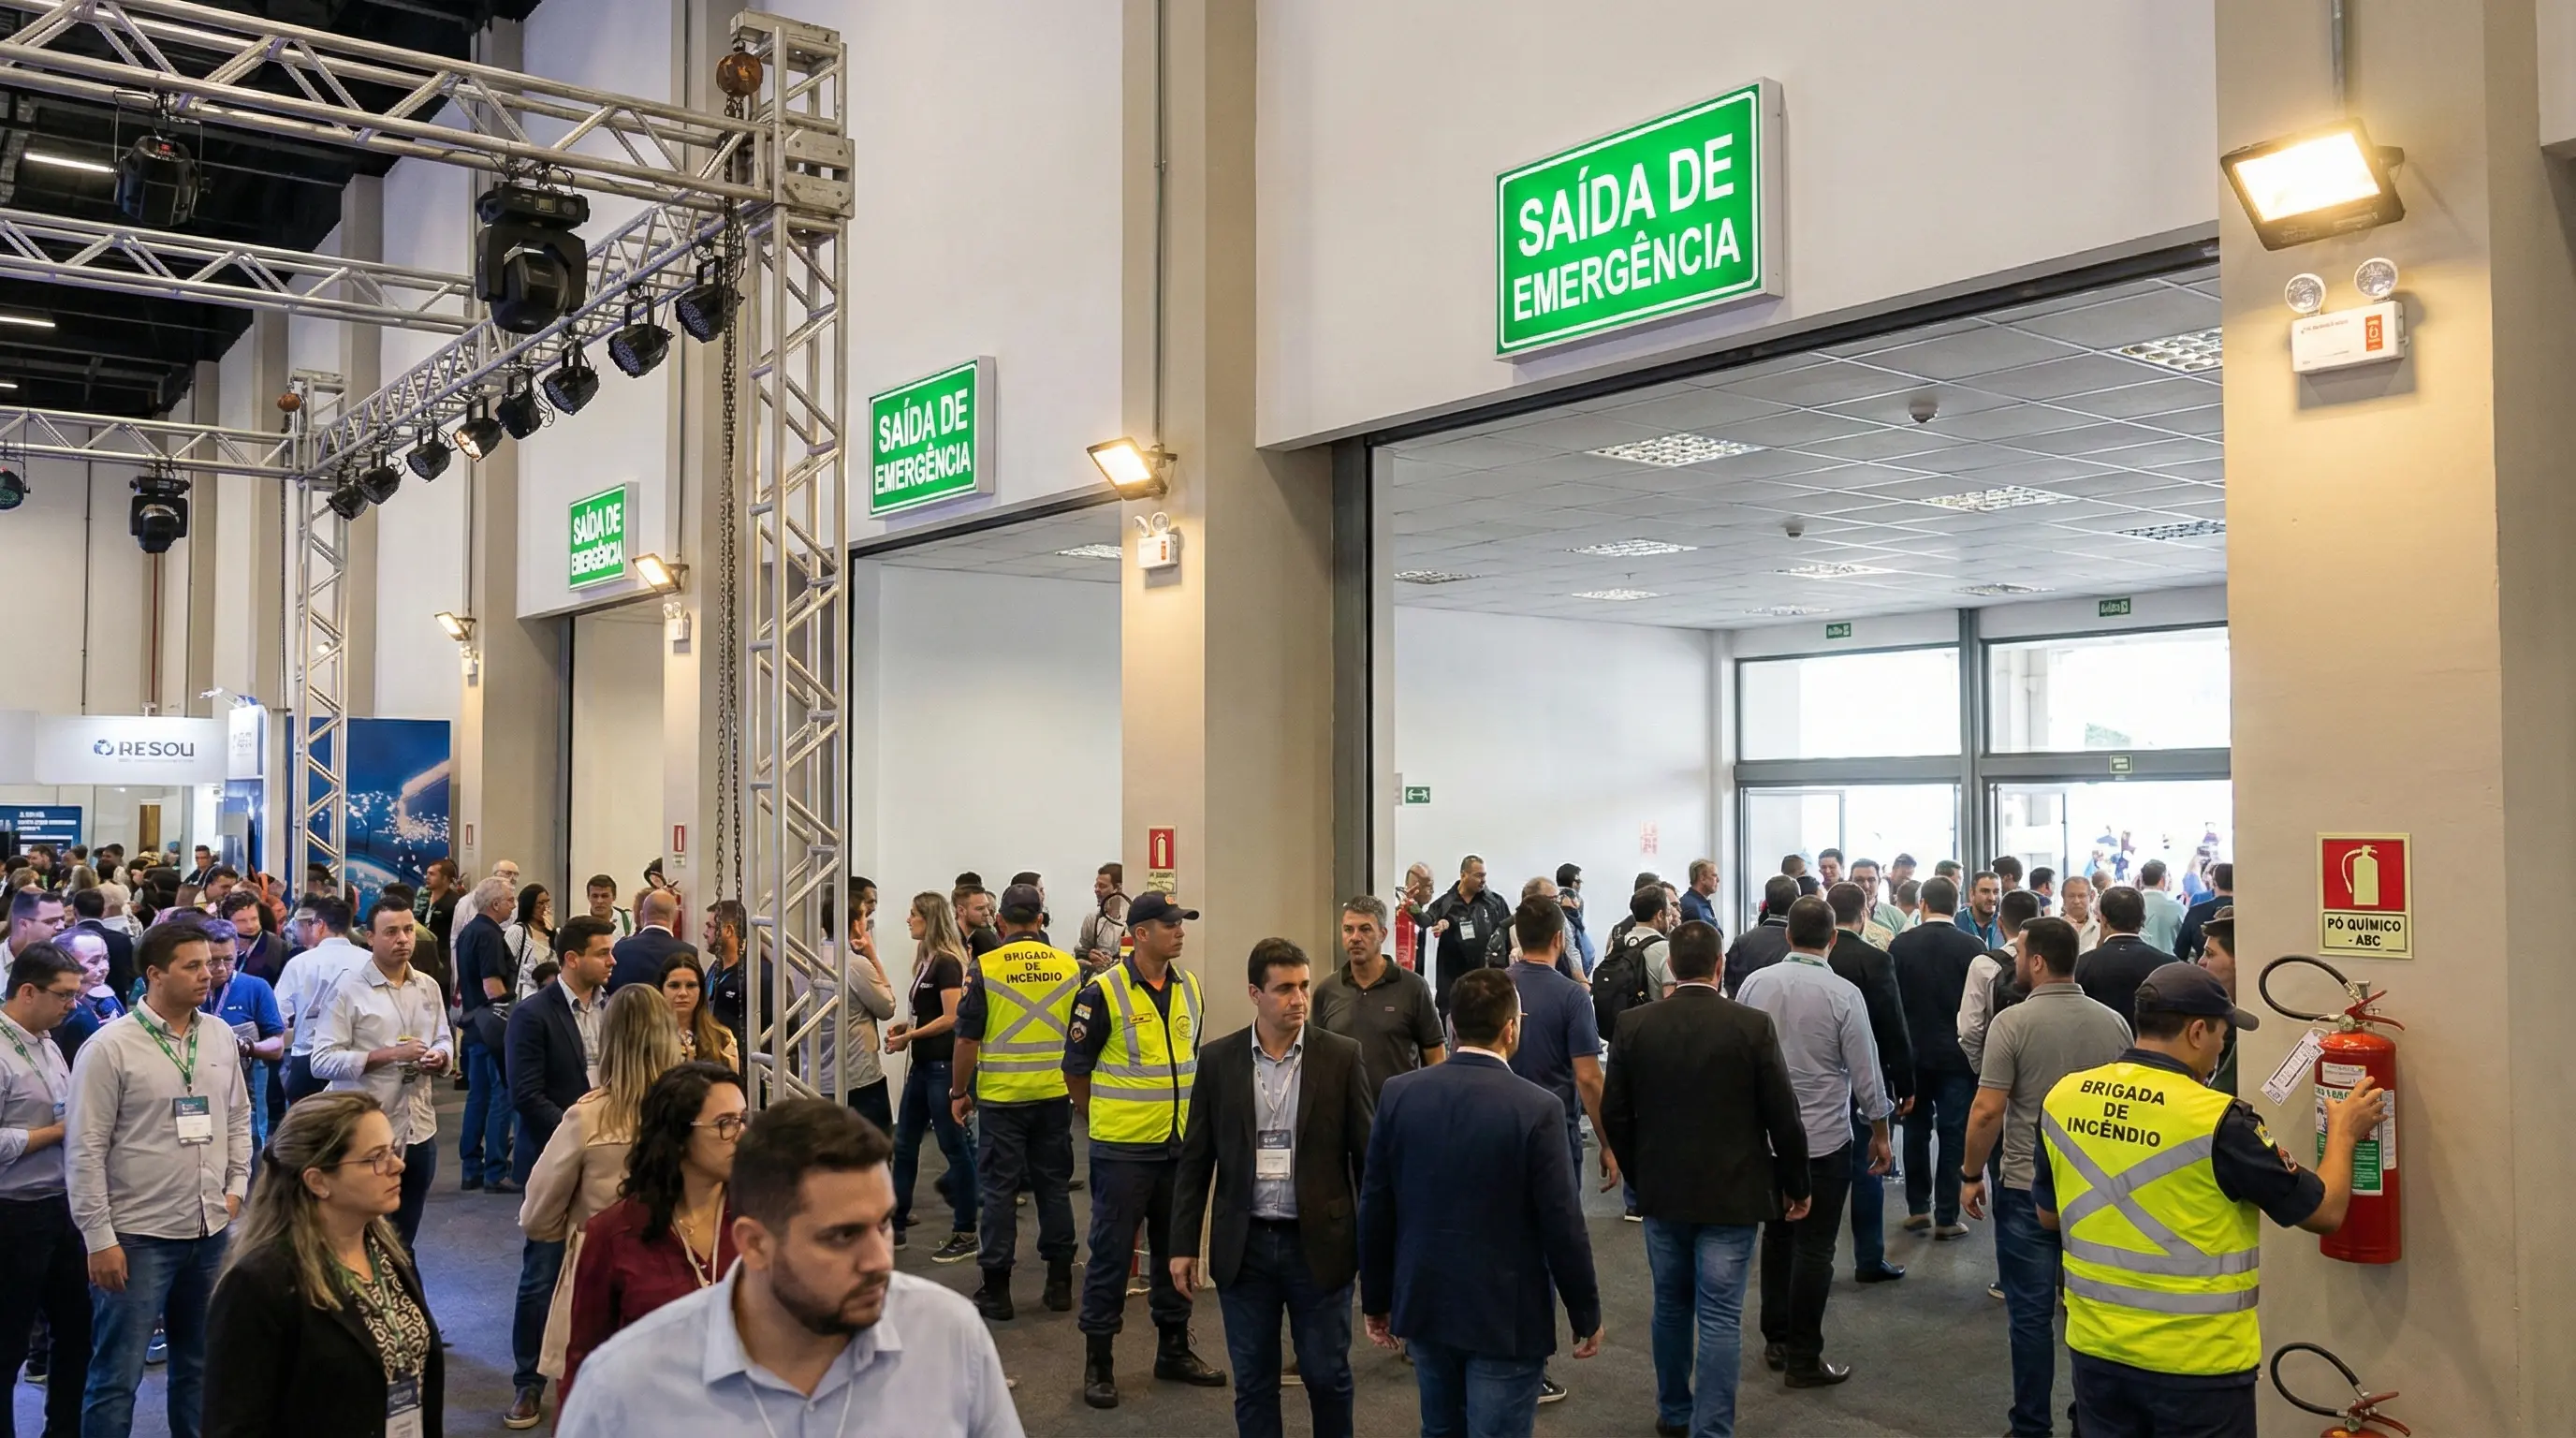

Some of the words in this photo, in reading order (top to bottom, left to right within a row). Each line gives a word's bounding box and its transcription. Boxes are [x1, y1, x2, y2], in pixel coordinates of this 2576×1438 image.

[1518, 163, 1657, 257] SAÍDA
[1669, 134, 1734, 213] DE
[1515, 218, 1741, 322] EMERGÊNCIA
[879, 397, 937, 453] SAÍDA
[941, 389, 968, 435] DE
[875, 441, 972, 495] EMERGÊNCIA
[573, 506, 605, 546] SAÍDA
[606, 503, 622, 536] DE
[2327, 916, 2344, 931] PÓ
[2348, 917, 2402, 932] QUÍMICO
[2356, 933, 2381, 946] ABC
[1003, 951, 1056, 961] BRIGADA
[1025, 962, 1041, 971] DE
[2081, 1080, 2165, 1106] BRIGADA
[2103, 1102, 2130, 1121] DE
